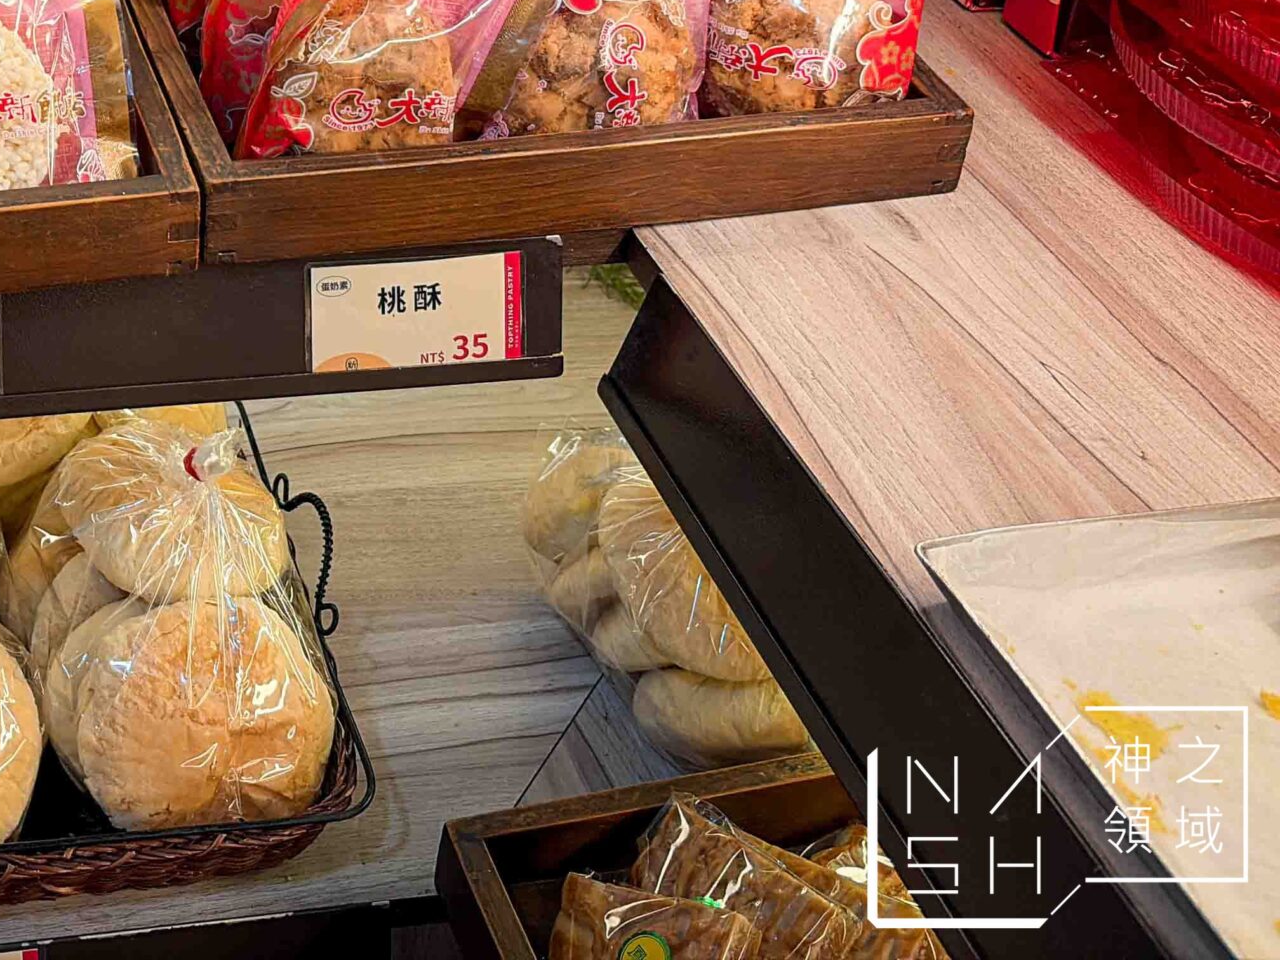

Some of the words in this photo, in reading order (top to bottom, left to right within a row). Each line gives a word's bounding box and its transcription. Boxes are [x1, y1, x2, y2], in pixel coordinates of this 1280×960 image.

[320, 280, 348, 292] 蛋奶素
[377, 282, 442, 315] 桃酥
[420, 350, 445, 365] NT$
[452, 333, 489, 360] 35
